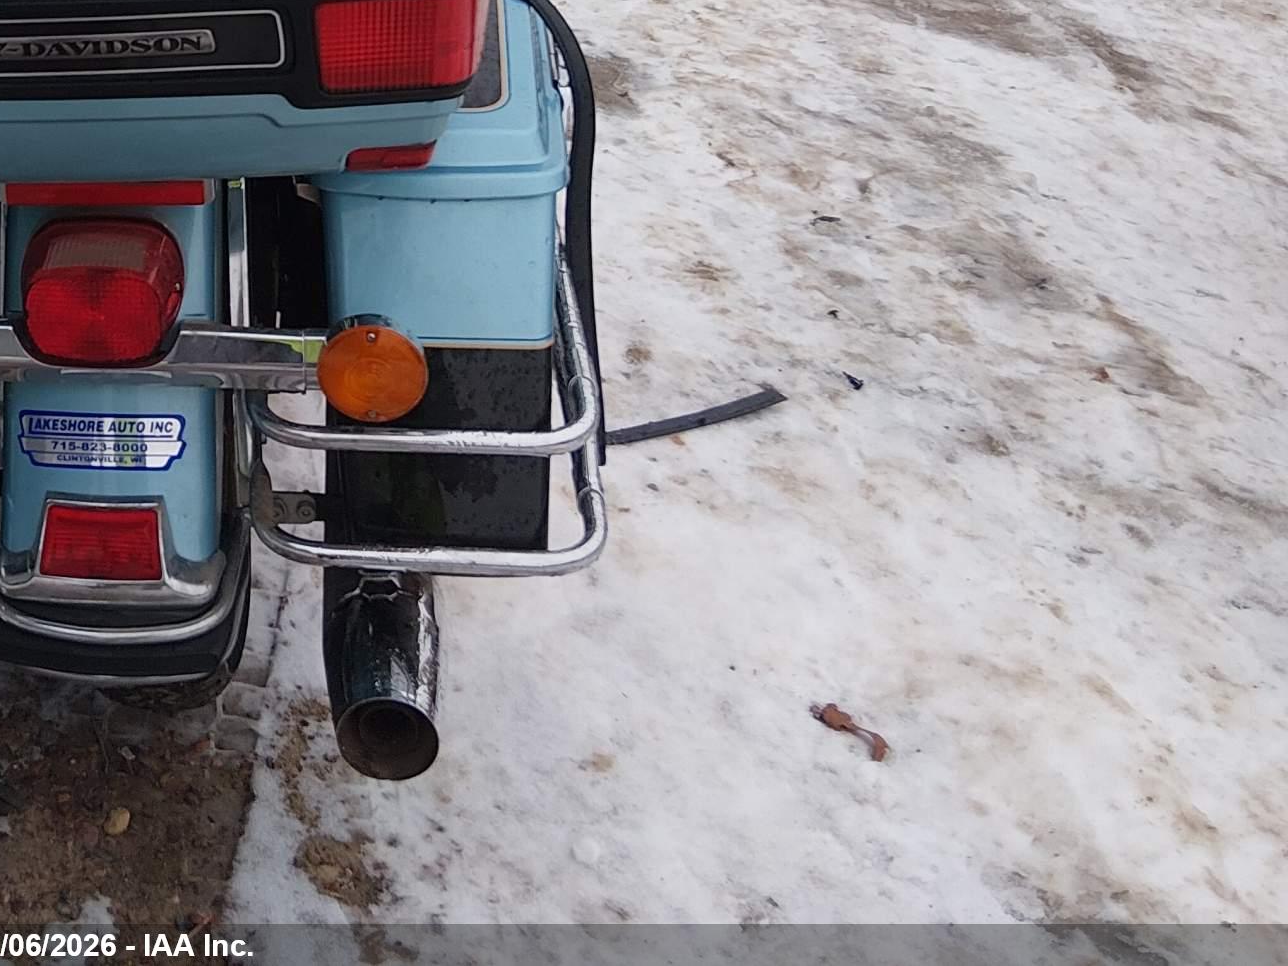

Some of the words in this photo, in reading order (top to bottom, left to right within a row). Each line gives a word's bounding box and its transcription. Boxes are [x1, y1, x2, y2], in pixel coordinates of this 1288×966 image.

[28, 417, 105, 435] LAKESHORE
[107, 420, 146, 433] AUTO
[150, 421, 174, 434] INC
[51, 440, 149, 453] 715-823-8000
